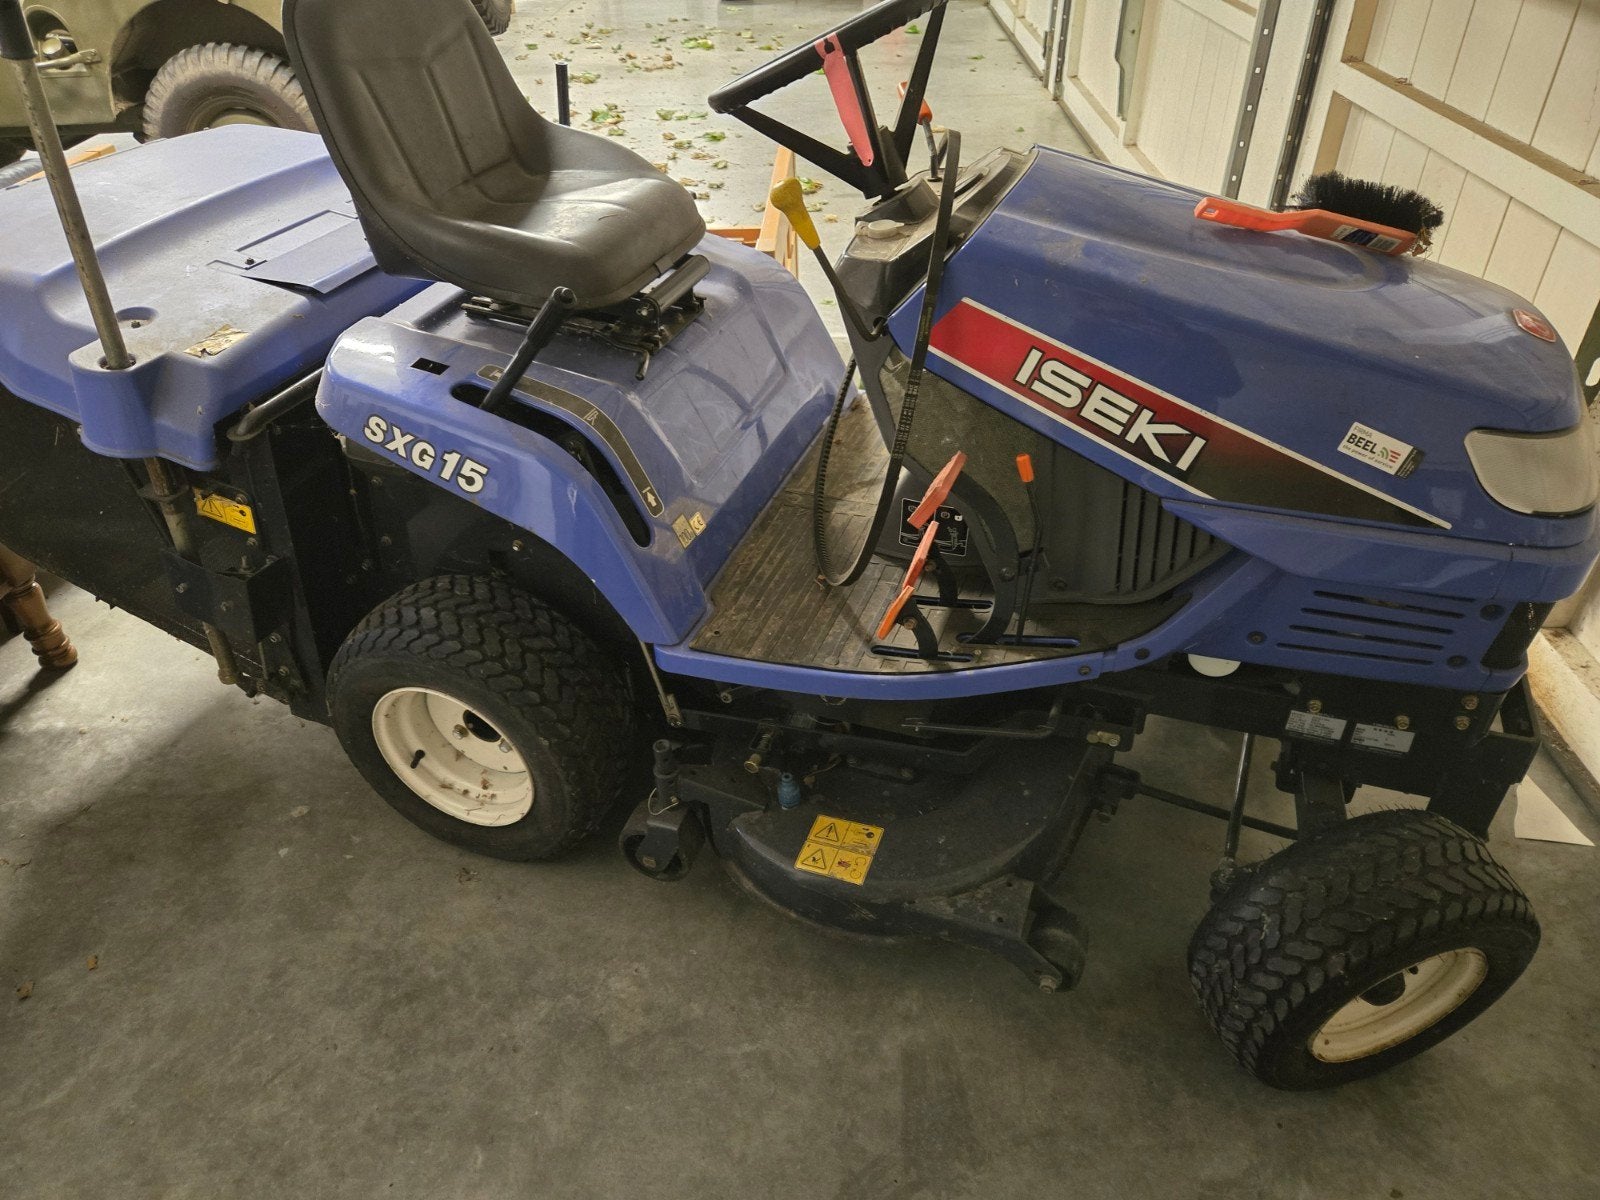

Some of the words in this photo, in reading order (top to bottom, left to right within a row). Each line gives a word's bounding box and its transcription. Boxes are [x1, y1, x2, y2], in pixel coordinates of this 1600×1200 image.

[1014, 346, 1207, 472] ISEKI
[1346, 433, 1377, 454] BEEL
[1351, 449, 1367, 458] power
